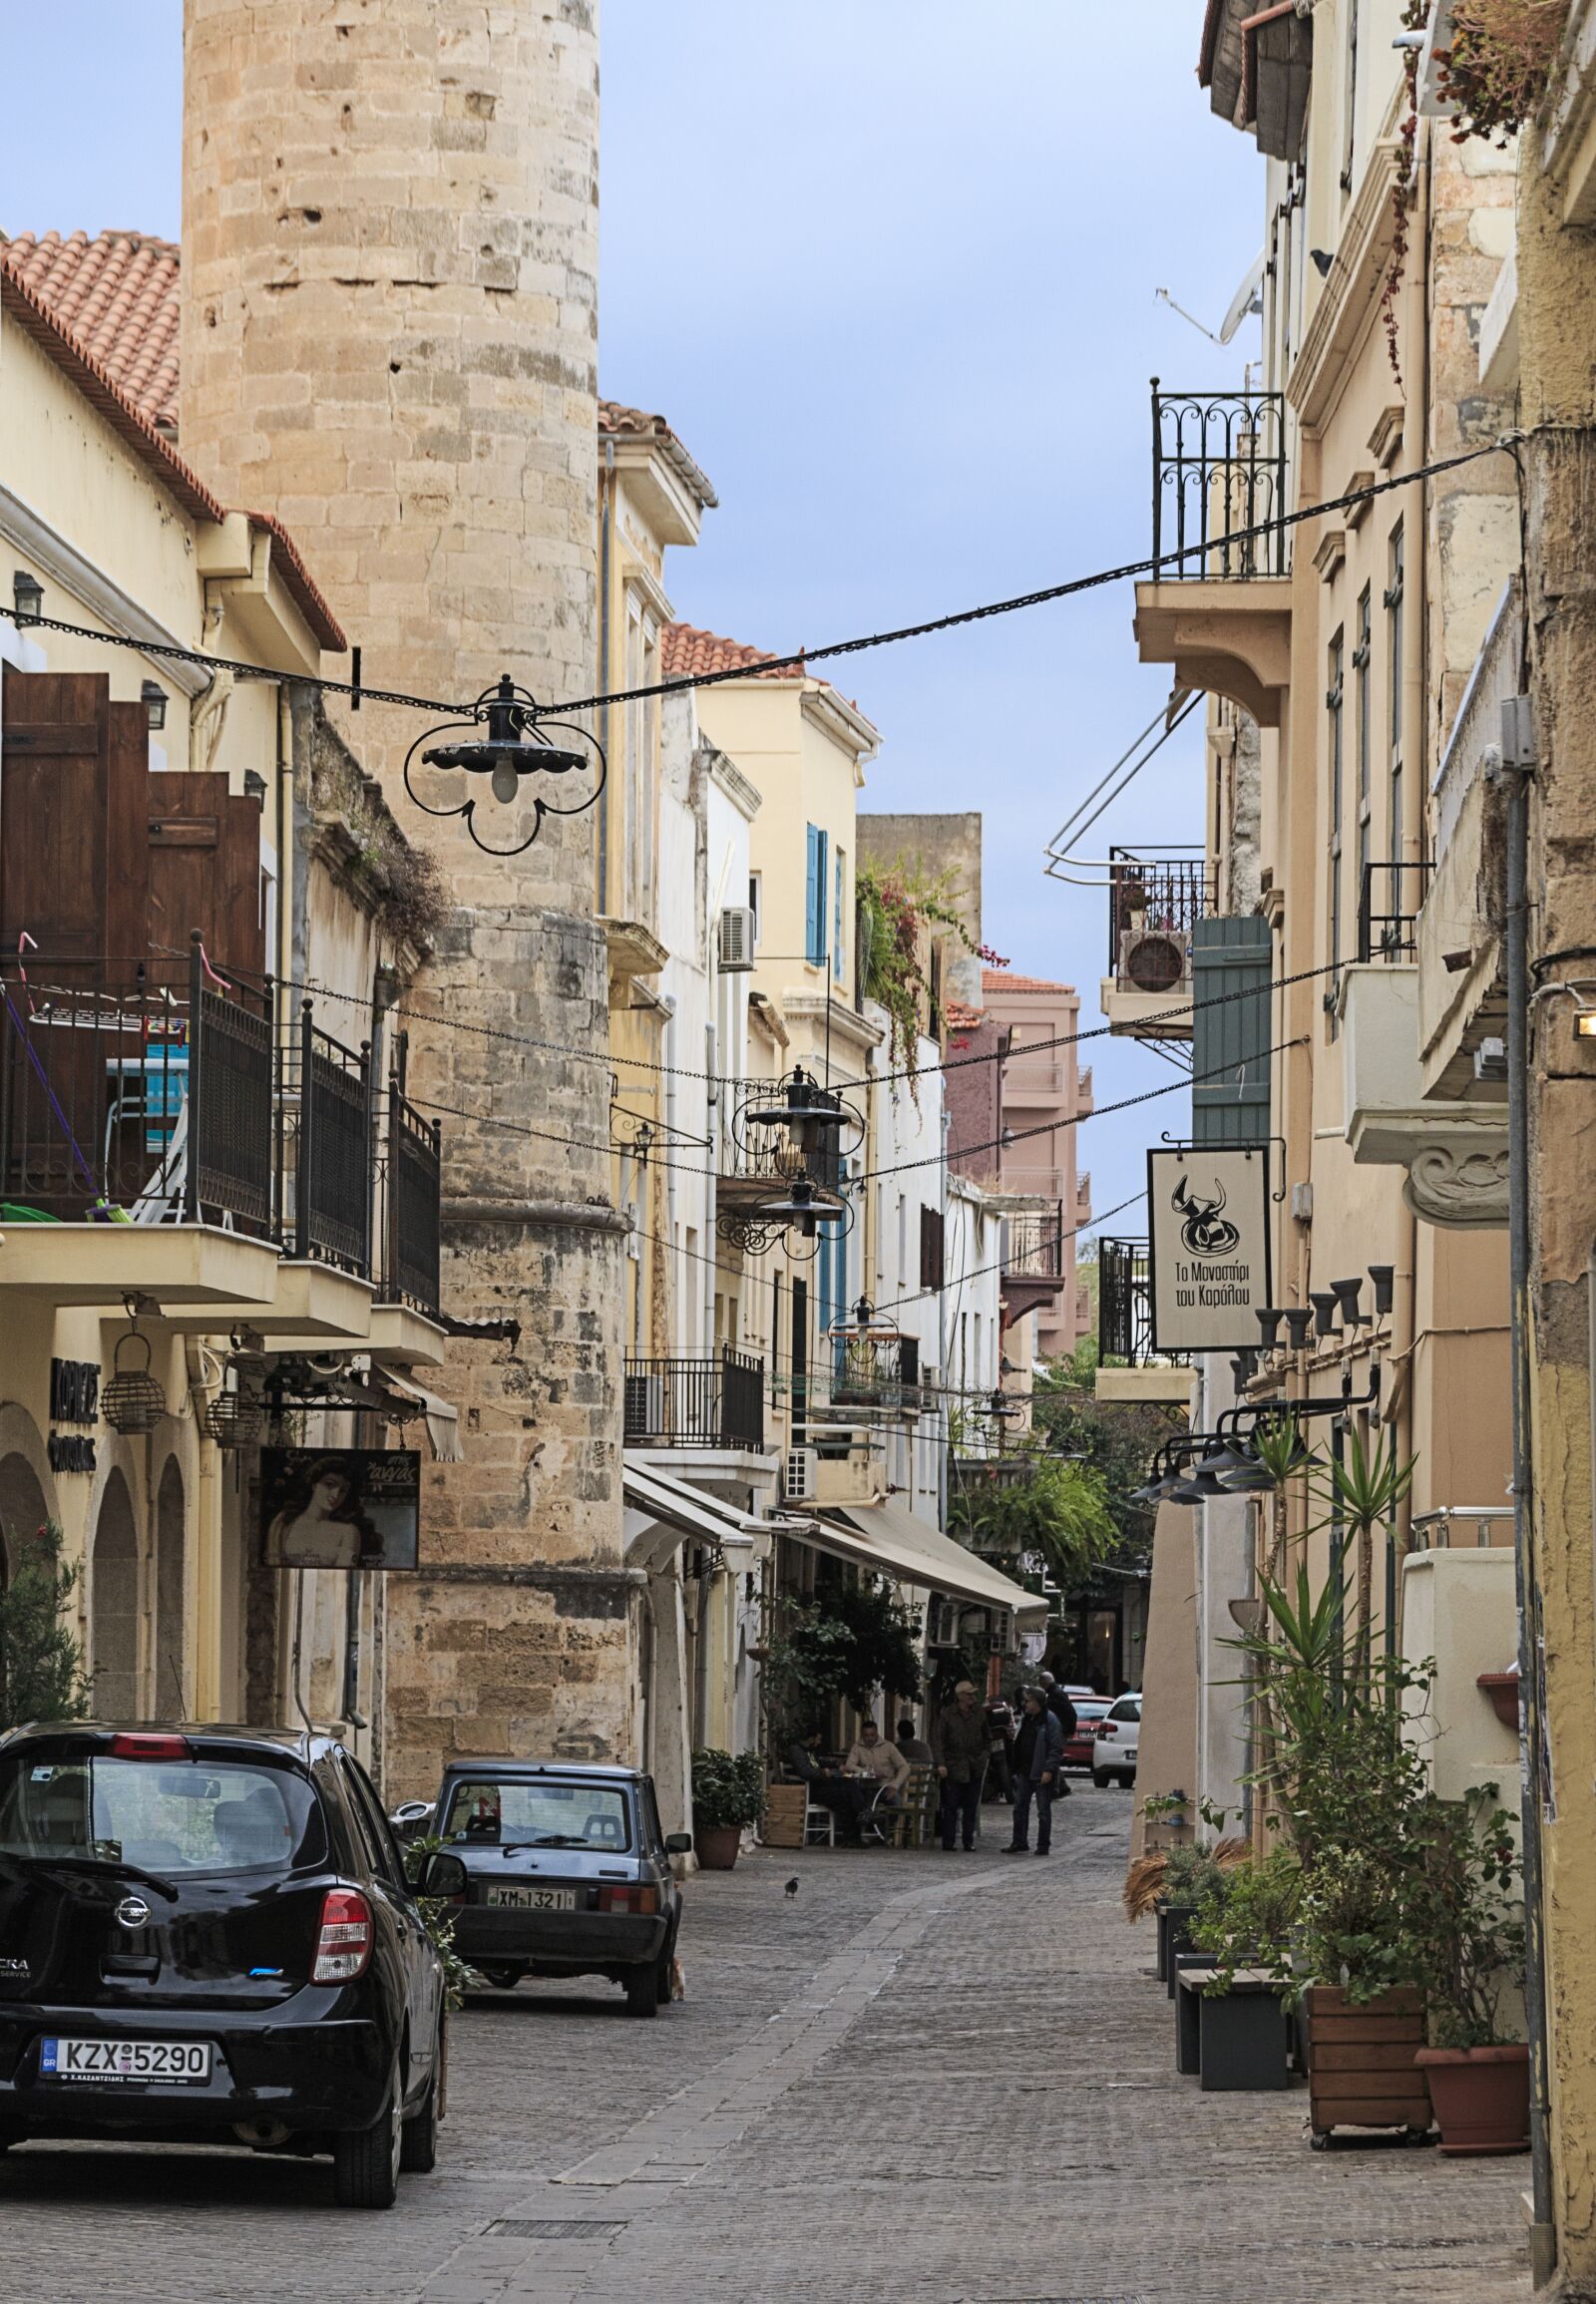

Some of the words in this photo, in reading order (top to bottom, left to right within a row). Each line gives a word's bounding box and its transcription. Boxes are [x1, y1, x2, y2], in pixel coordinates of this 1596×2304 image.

[1175, 1262, 1188, 1283] Το
[1191, 1260, 1250, 1283] Μοναστήρι
[1175, 1289, 1195, 1307] του
[1198, 1284, 1250, 1309] Καρόλου
